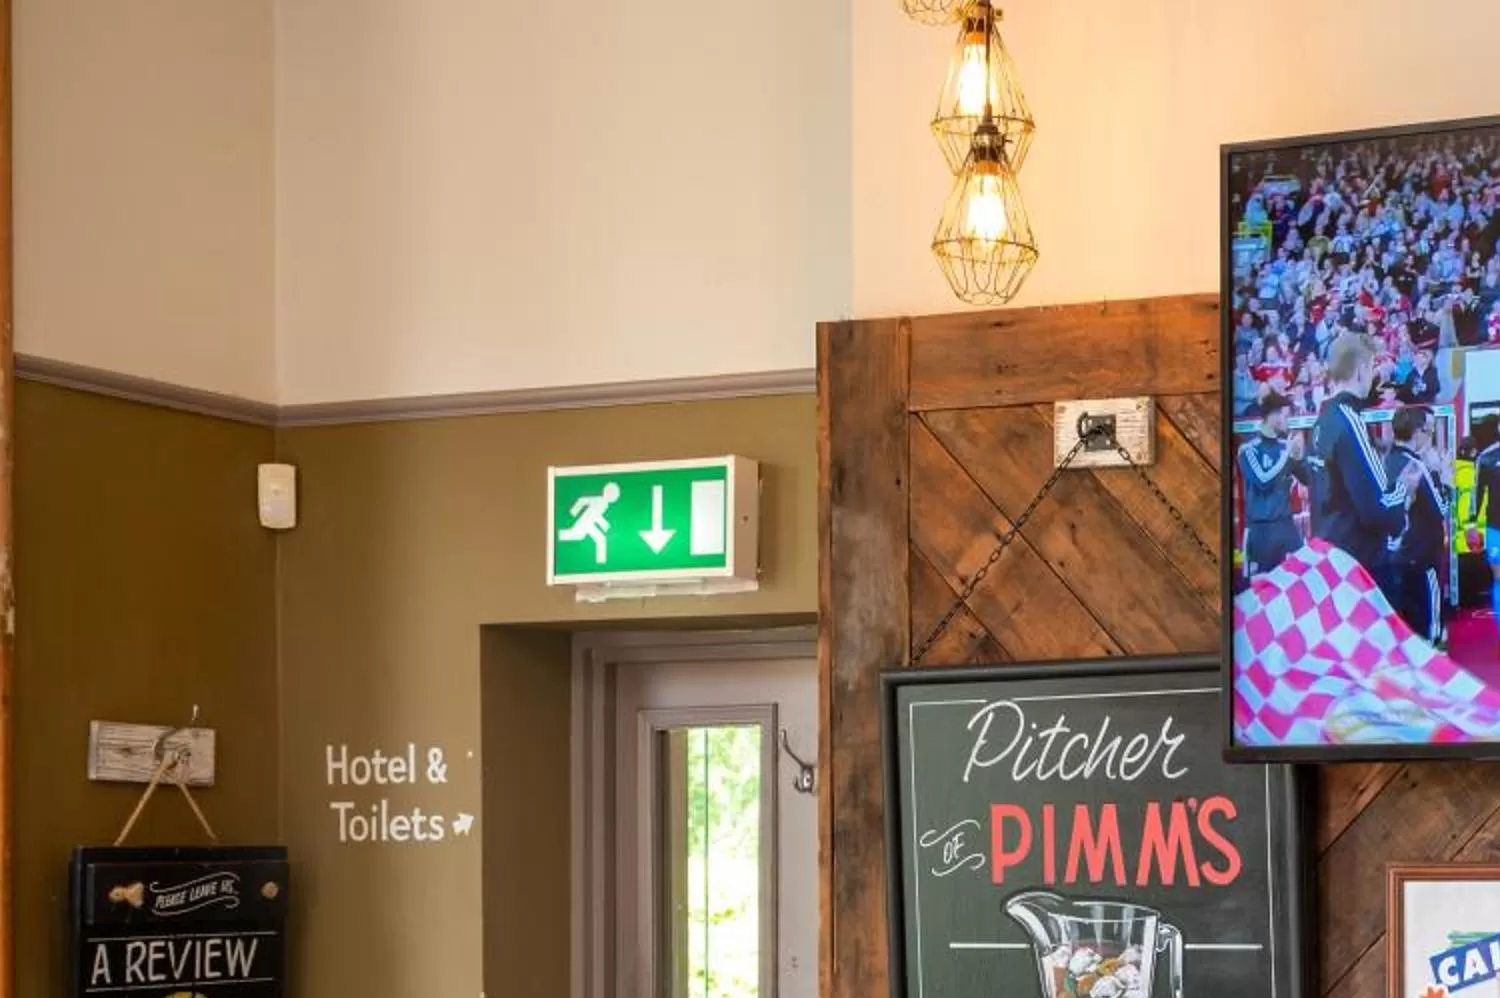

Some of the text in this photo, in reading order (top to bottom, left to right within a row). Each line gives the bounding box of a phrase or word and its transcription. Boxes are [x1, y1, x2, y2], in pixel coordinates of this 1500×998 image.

[326, 743, 448, 785] Hotel &
[963, 700, 1189, 783] Pitcher
[330, 799, 445, 842] Toilets
[990, 796, 1242, 888] PIMM'S
[943, 831, 966, 865] OF
[91, 937, 259, 985] A REVIEW
